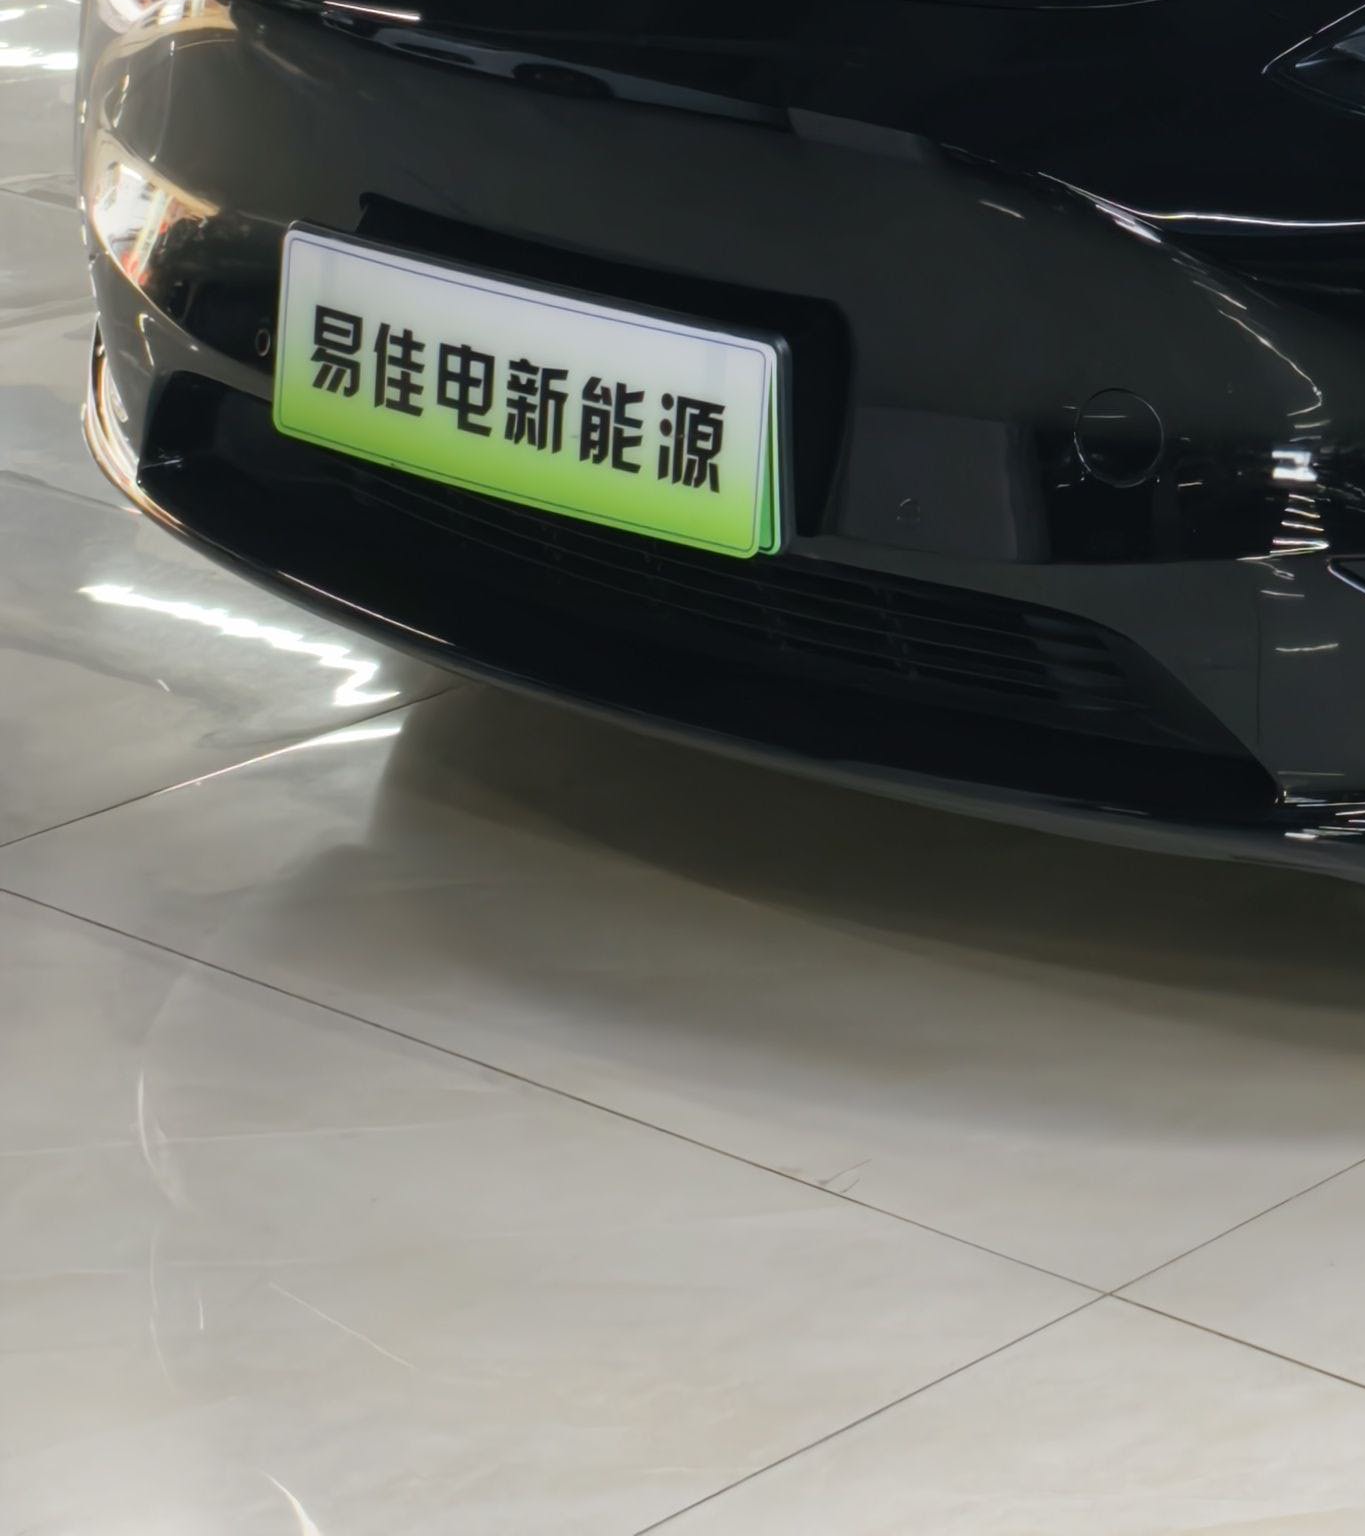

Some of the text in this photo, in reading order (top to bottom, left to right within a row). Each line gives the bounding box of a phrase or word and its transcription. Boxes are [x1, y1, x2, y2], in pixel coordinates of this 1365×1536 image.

[310, 303, 726, 494] 易佳电新能源
